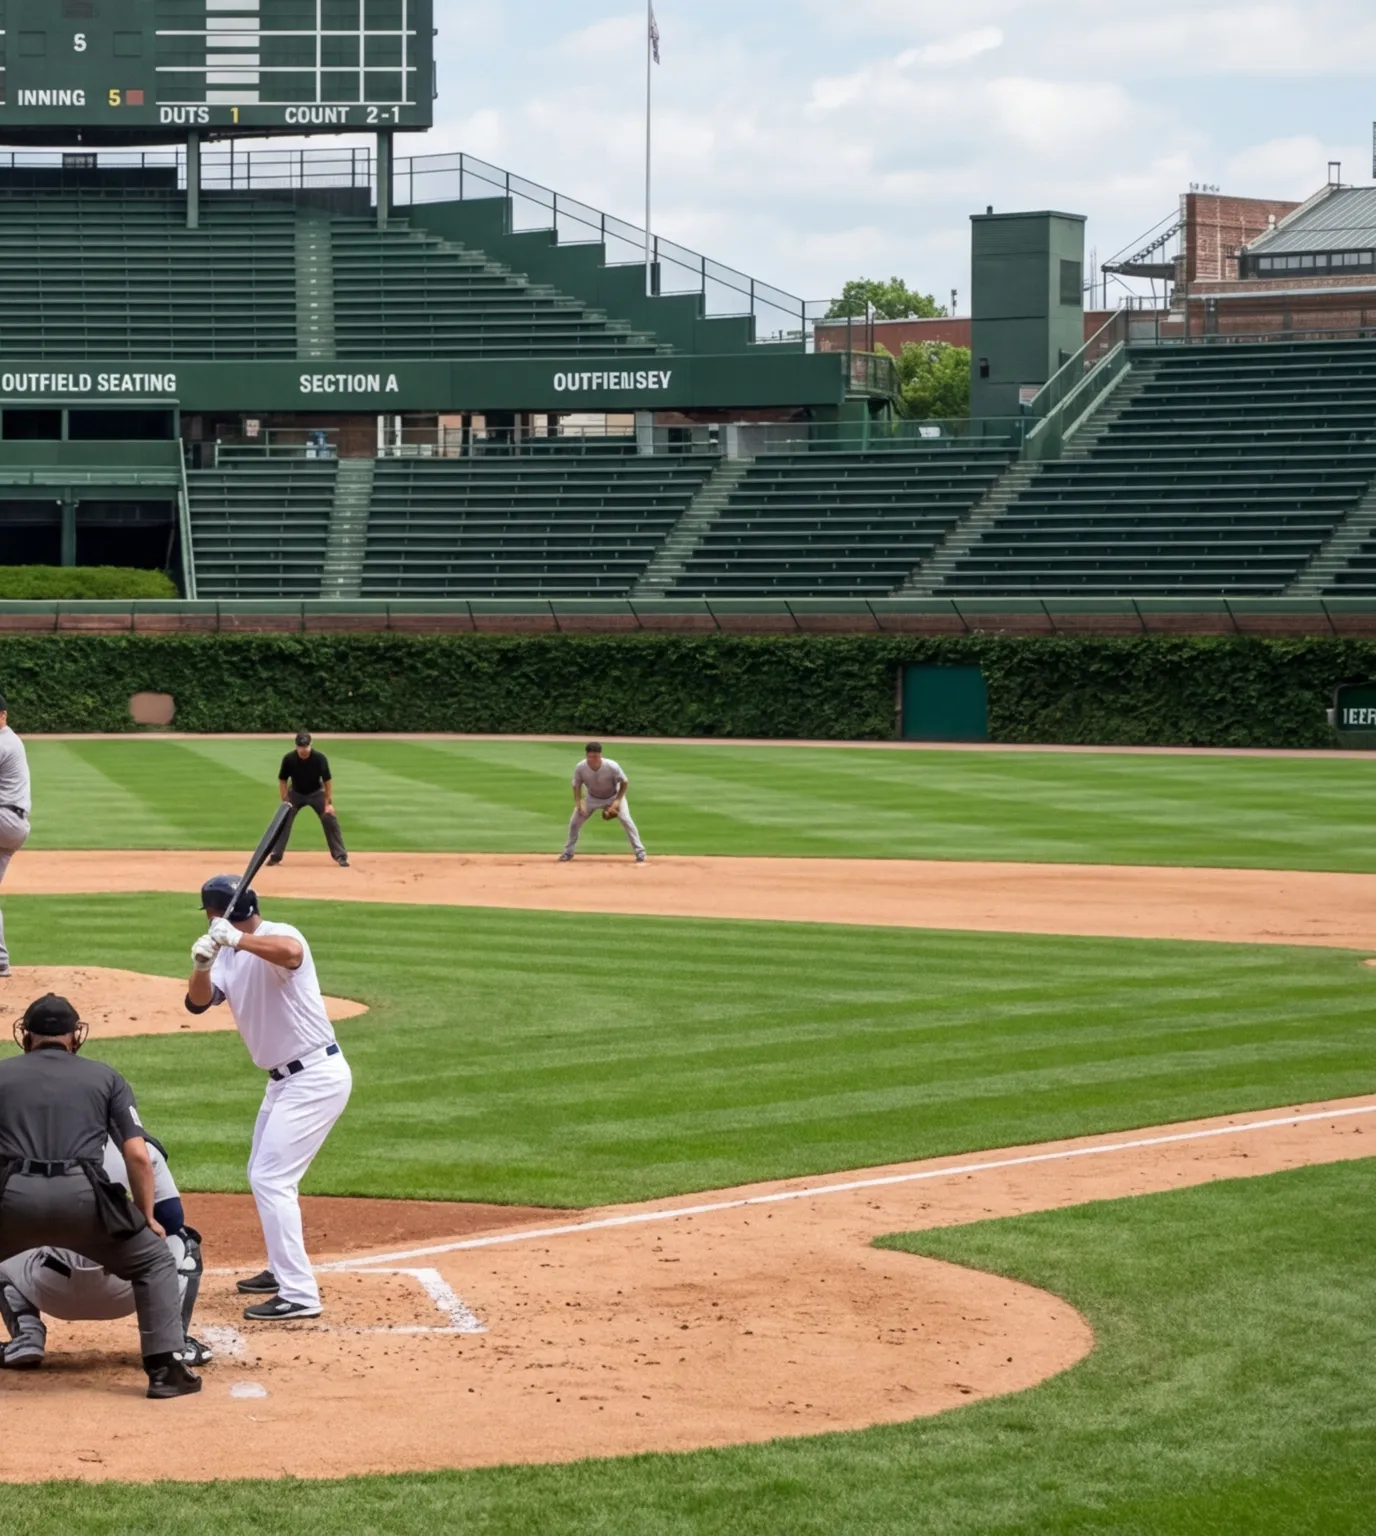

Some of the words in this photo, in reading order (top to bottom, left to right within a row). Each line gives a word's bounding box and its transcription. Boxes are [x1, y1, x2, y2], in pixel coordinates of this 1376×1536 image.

[73, 33, 87, 52] 5
[17, 89, 86, 106] INNING
[108, 89, 121, 107] 5
[230, 106, 239, 124] 1
[284, 106, 350, 124] COUNT
[366, 105, 400, 124] 2-1
[1, 373, 92, 392] OUTFIELD
[97, 373, 176, 392] SEATING
[299, 374, 380, 393] SECTION
[385, 374, 399, 392] A
